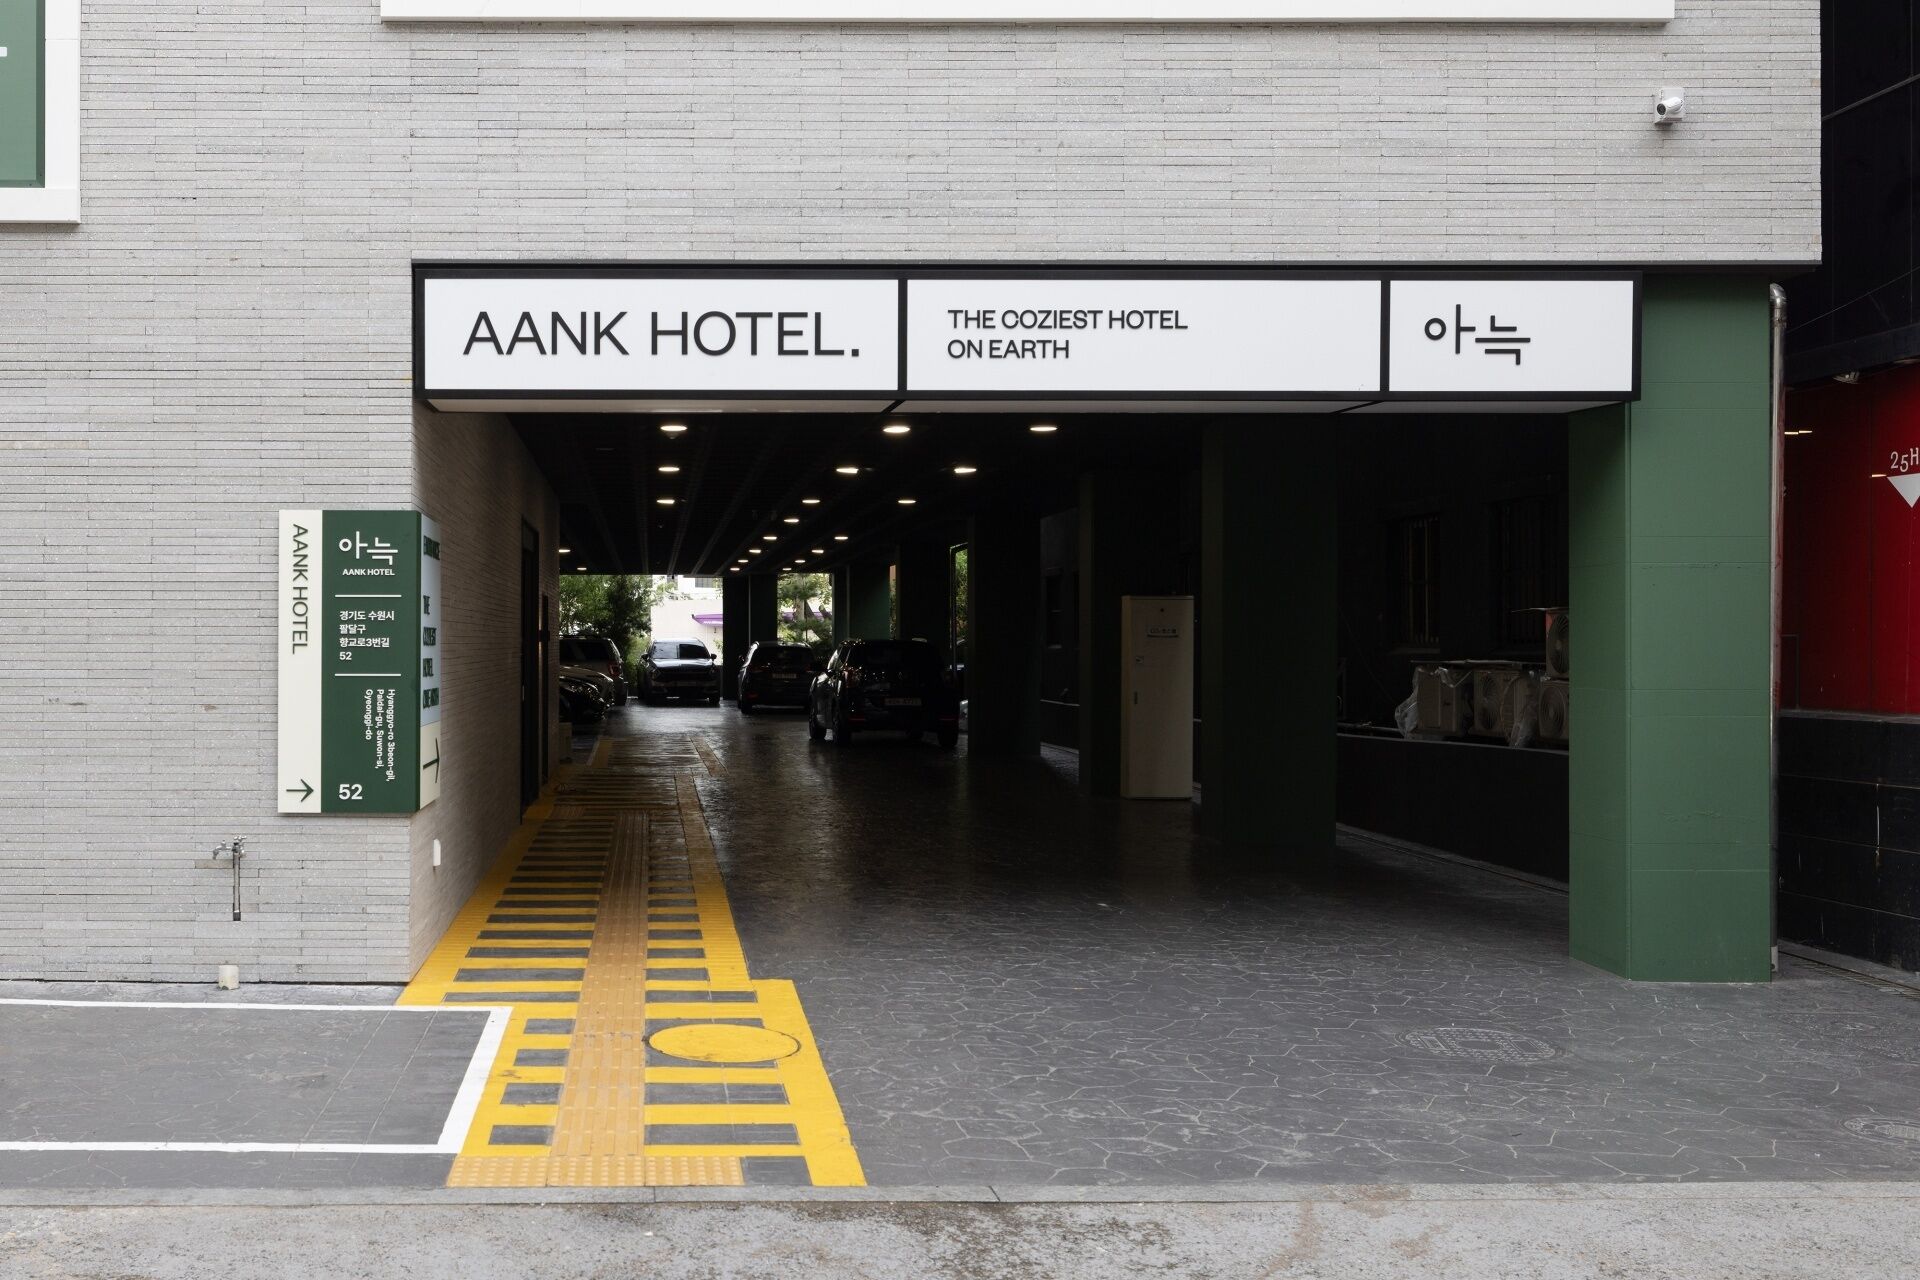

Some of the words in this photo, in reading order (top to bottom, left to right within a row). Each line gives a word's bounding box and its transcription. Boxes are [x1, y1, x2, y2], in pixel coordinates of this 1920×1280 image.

[462, 311, 630, 356] AANK
[651, 310, 860, 357] HOTEL.
[947, 309, 996, 329] THE
[1001, 309, 1104, 330] COZIEST
[1108, 309, 1189, 330] HOTEL
[1424, 303, 1531, 366] 아늑
[947, 339, 983, 359] ON
[989, 339, 1070, 359] EARTH
[292, 523, 309, 582] AANK
[338, 530, 399, 566] 아늑
[342, 568, 366, 576] AANK
[367, 568, 395, 576] HOTEL
[292, 586, 309, 655] HOTEL
[339, 610, 367, 621] 경기도
[368, 610, 395, 621] 수원시
[339, 624, 367, 635] 팔달구
[339, 637, 390, 648] 향교로3번길
[339, 651, 353, 661] 52
[364, 689, 374, 740] Gyeonggi-do
[375, 689, 385, 729] Paldal-gu,
[386, 689, 396, 741] Hyanggyo-ro
[375, 730, 385, 769] Suwon-si,
[386, 741, 396, 782] 3beon-gil,
[338, 783, 363, 800] 52
